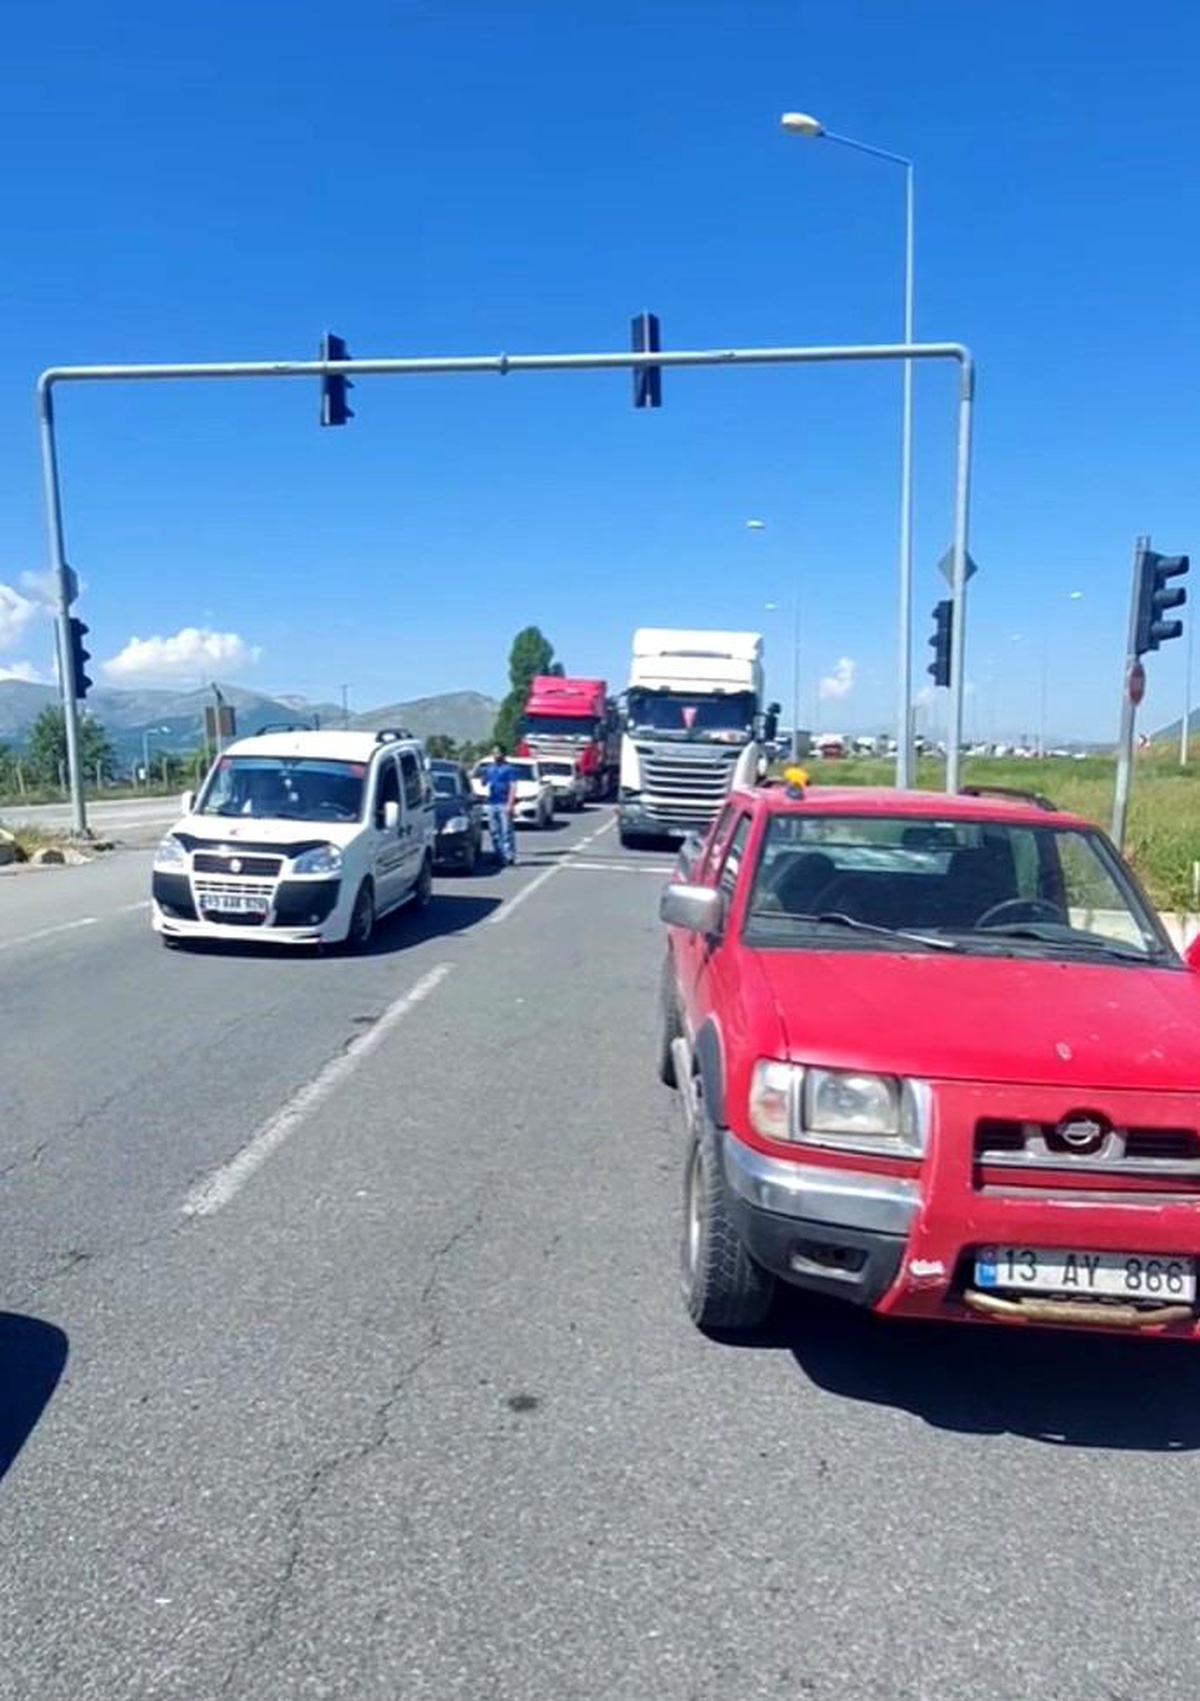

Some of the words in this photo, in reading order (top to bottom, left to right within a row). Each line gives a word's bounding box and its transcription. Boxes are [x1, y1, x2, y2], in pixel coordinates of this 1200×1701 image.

[1005, 1250, 1038, 1282] 13
[1062, 1253, 1100, 1288] AY
[1125, 1258, 1184, 1294] 866
